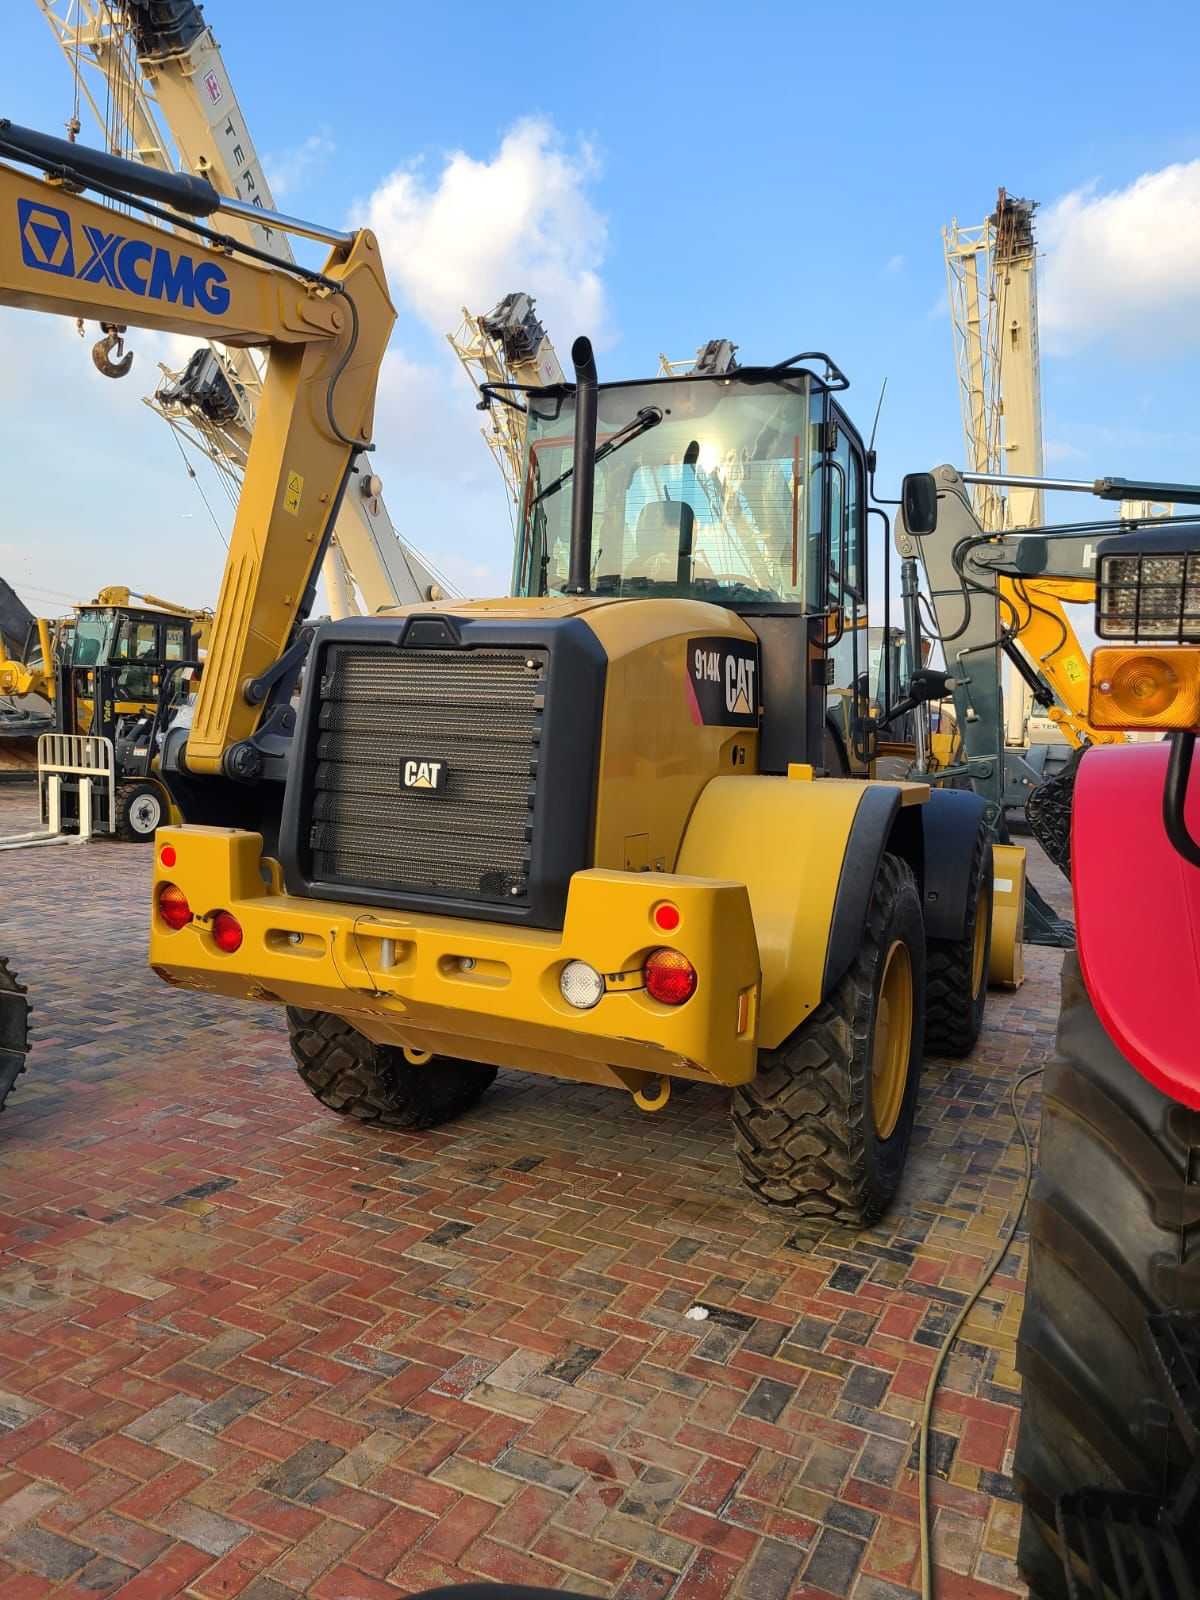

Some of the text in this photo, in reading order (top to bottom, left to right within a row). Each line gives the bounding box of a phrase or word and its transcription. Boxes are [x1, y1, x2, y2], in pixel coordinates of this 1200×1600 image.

[76, 224, 231, 316] XCMG
[694, 648, 721, 682] 914K
[725, 654, 755, 714] CAT
[103, 700, 112, 722] Yale
[404, 761, 441, 789] CAT
